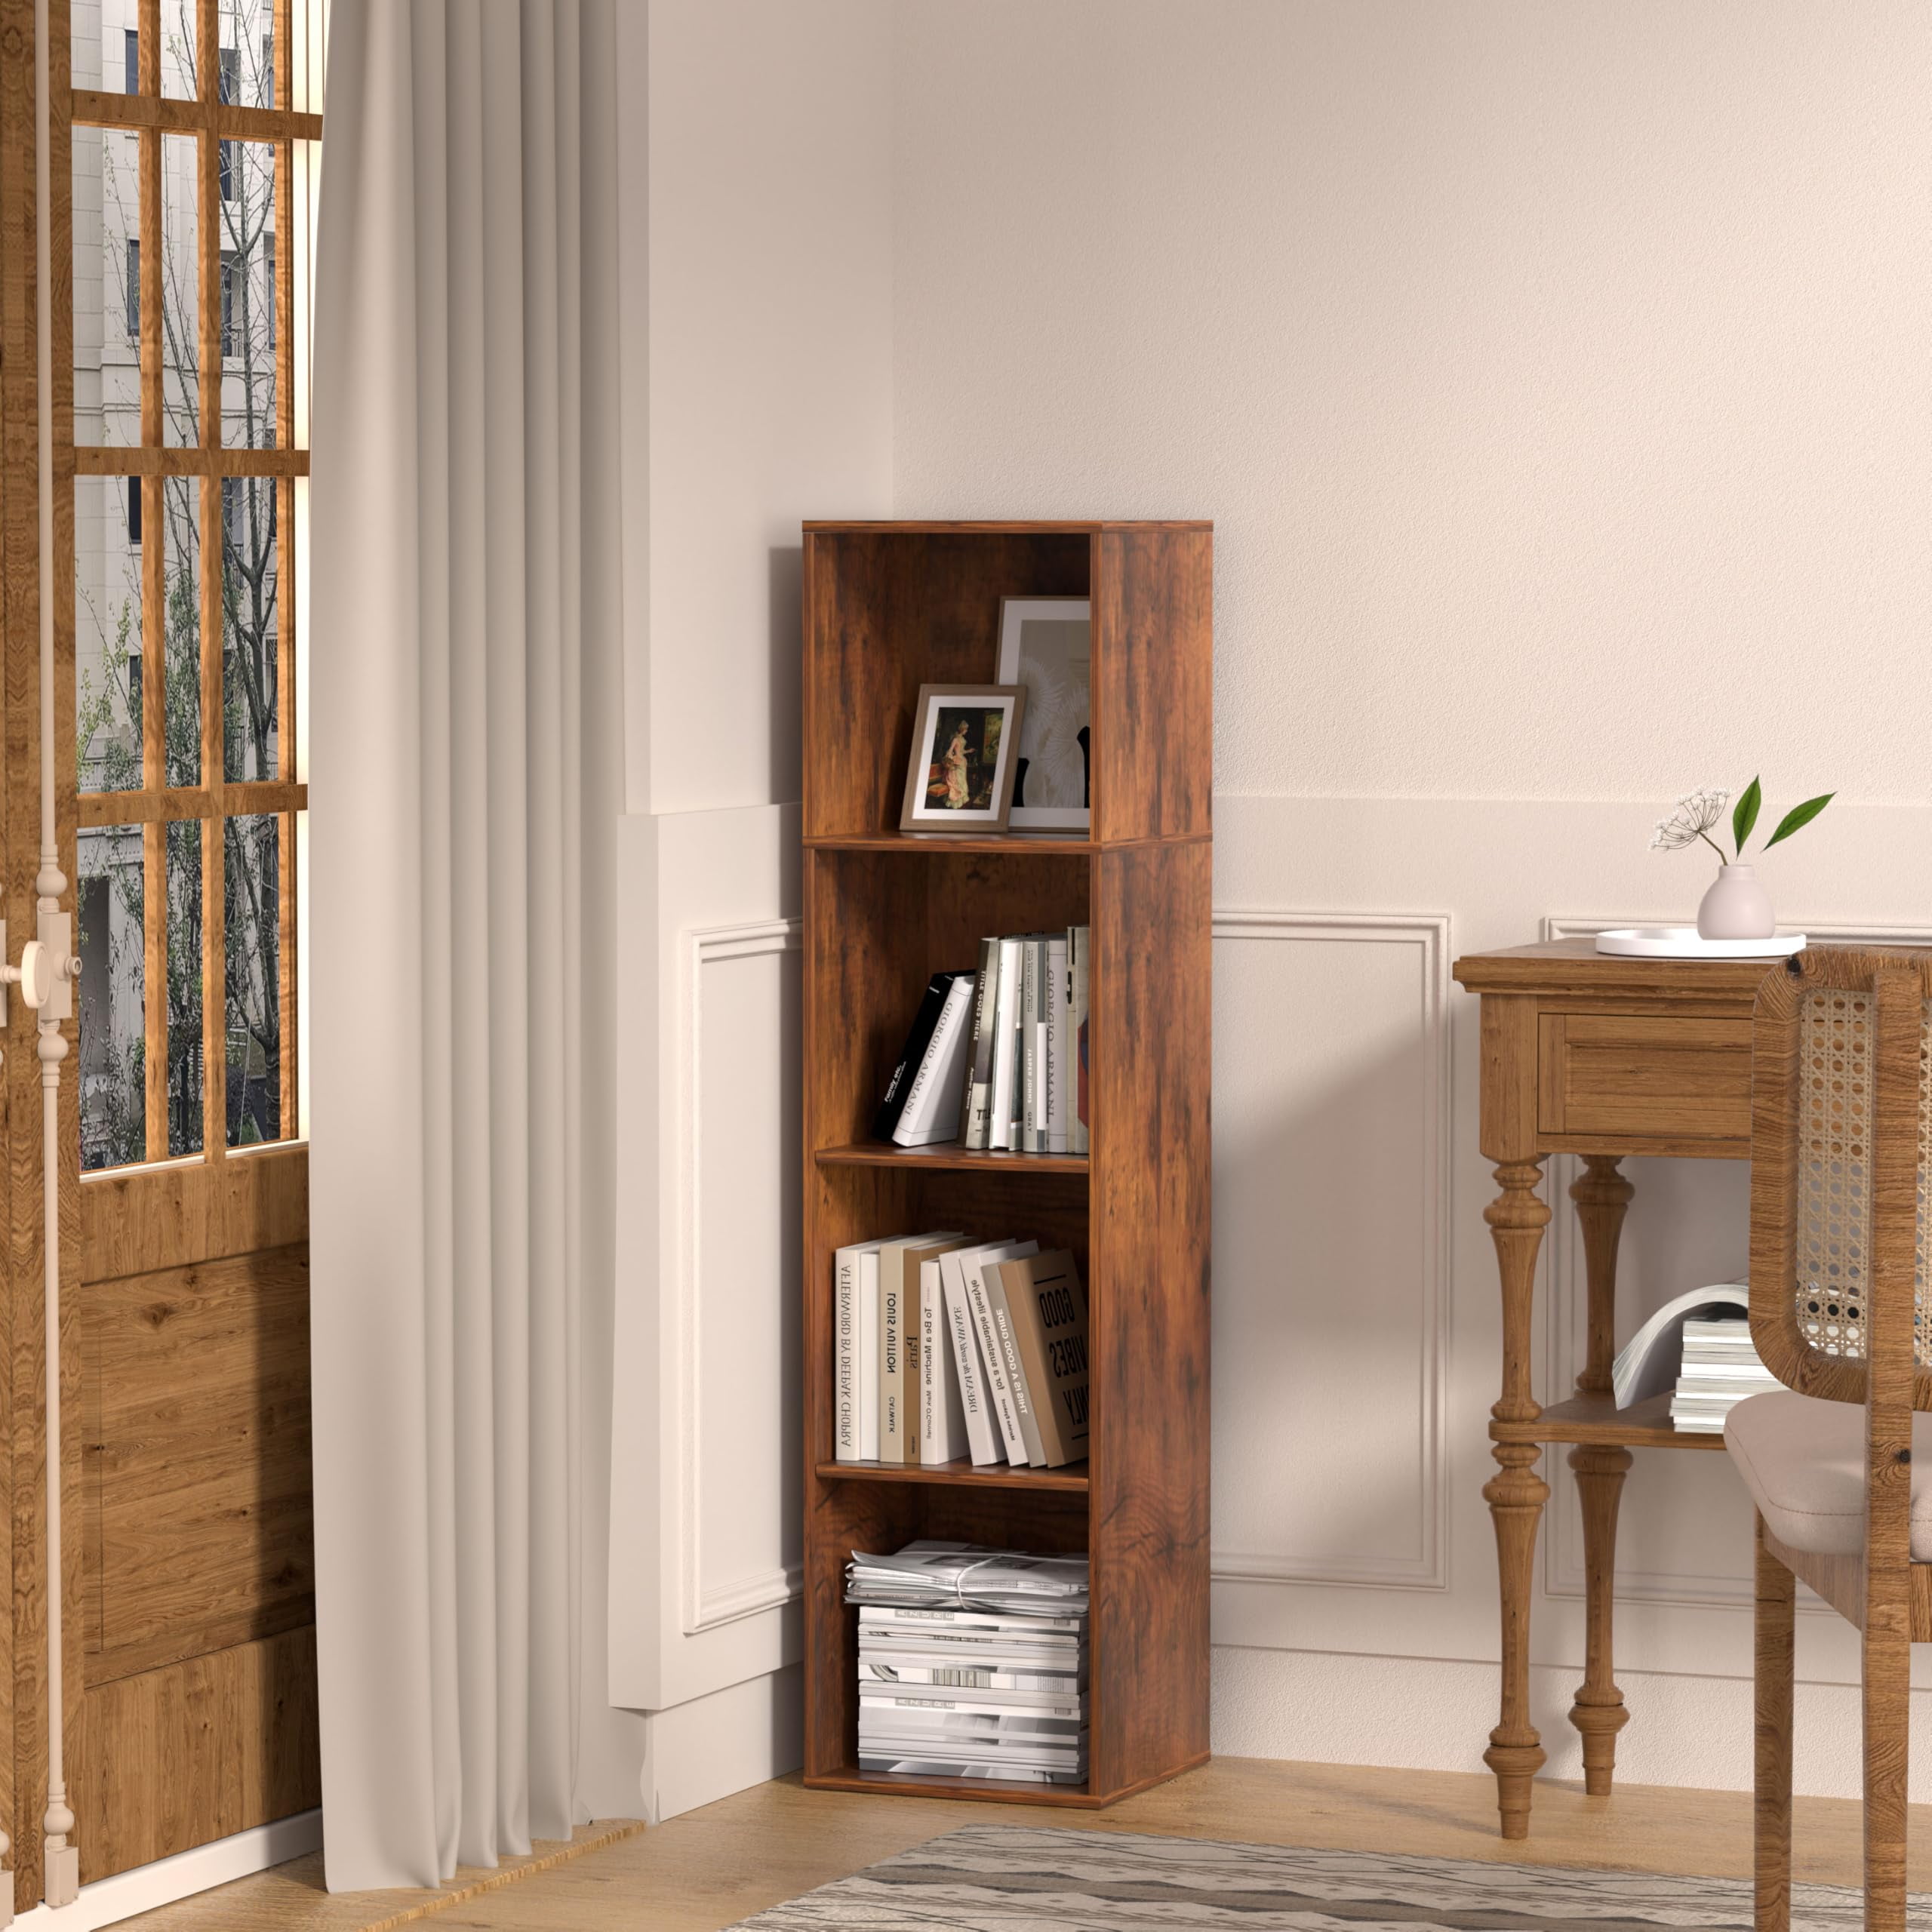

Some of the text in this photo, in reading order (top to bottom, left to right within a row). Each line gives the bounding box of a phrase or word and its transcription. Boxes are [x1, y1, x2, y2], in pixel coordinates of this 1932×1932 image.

[928, 1001, 952, 1059] GIORGIO
[904, 1062, 929, 1116] ARMANI
[897, 1610, 954, 1620] AZURE
